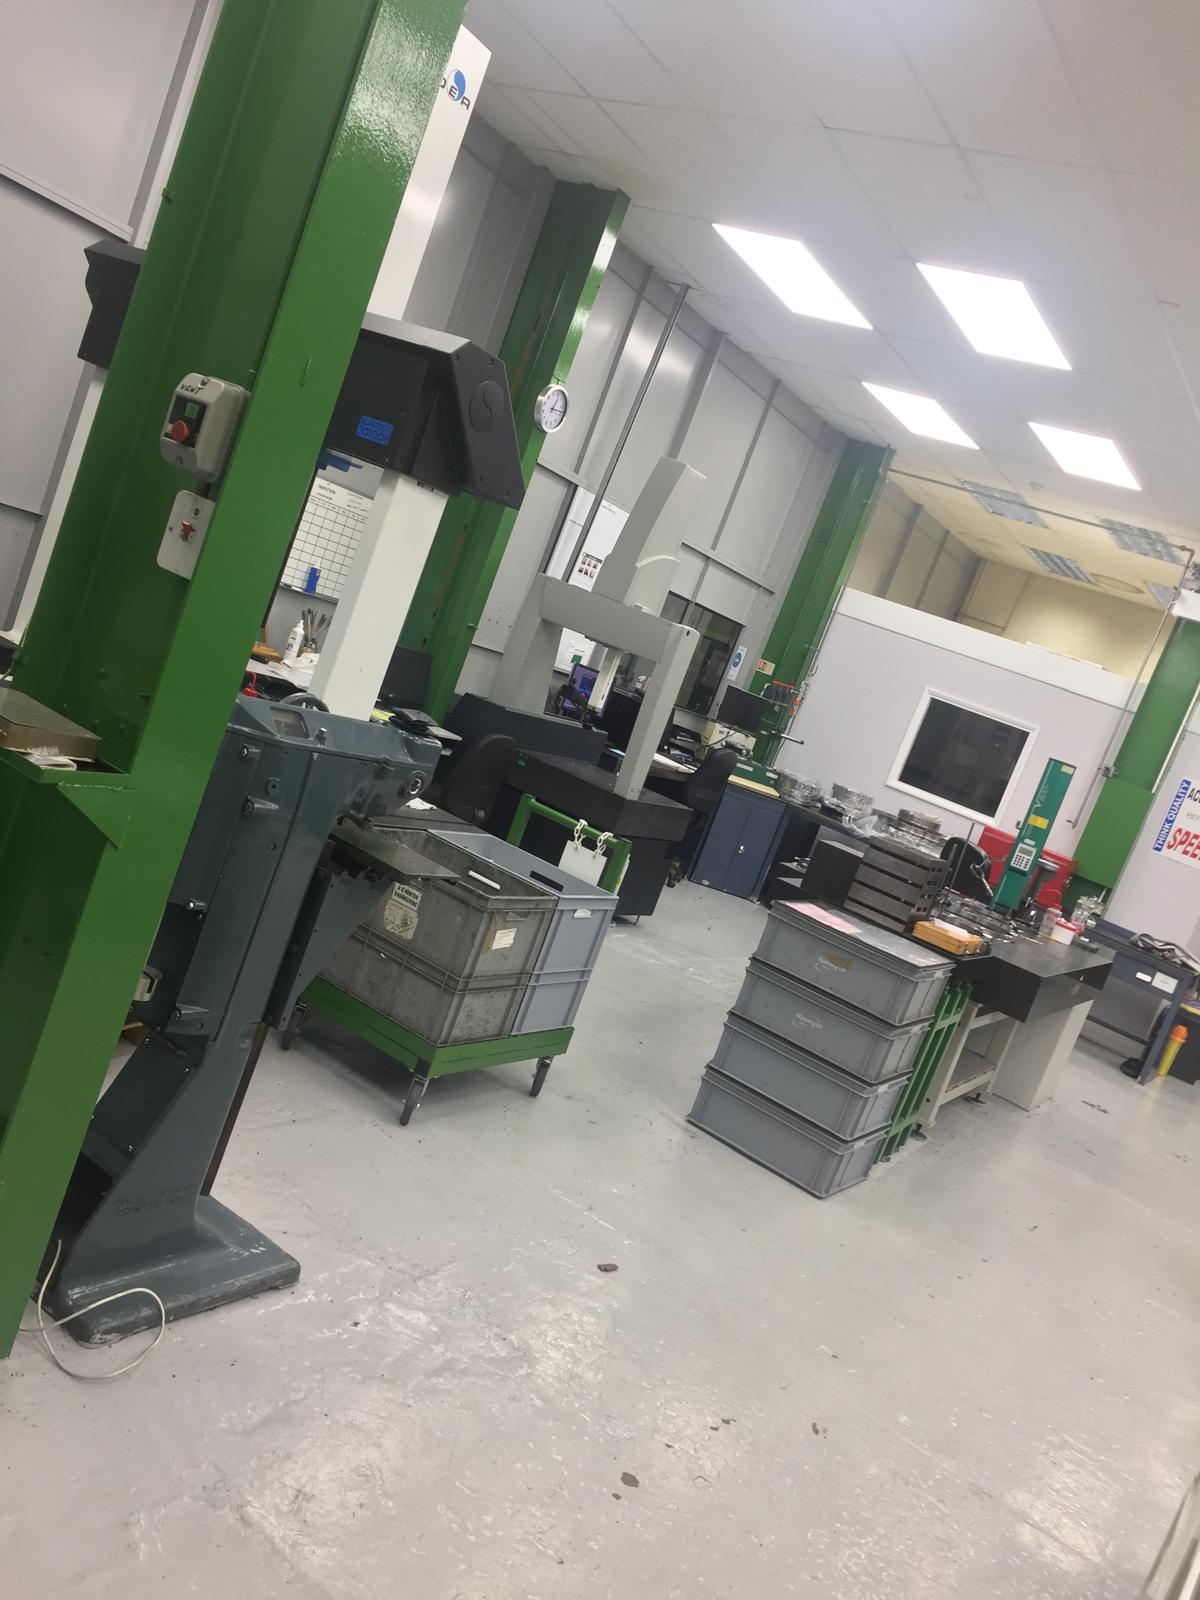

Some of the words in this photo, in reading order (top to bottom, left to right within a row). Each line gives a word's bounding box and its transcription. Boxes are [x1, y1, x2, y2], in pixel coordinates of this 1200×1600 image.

[1154, 821, 1172, 850] THINK
[1167, 781, 1190, 821] QUALITY
[1187, 788, 1200, 804] AC
